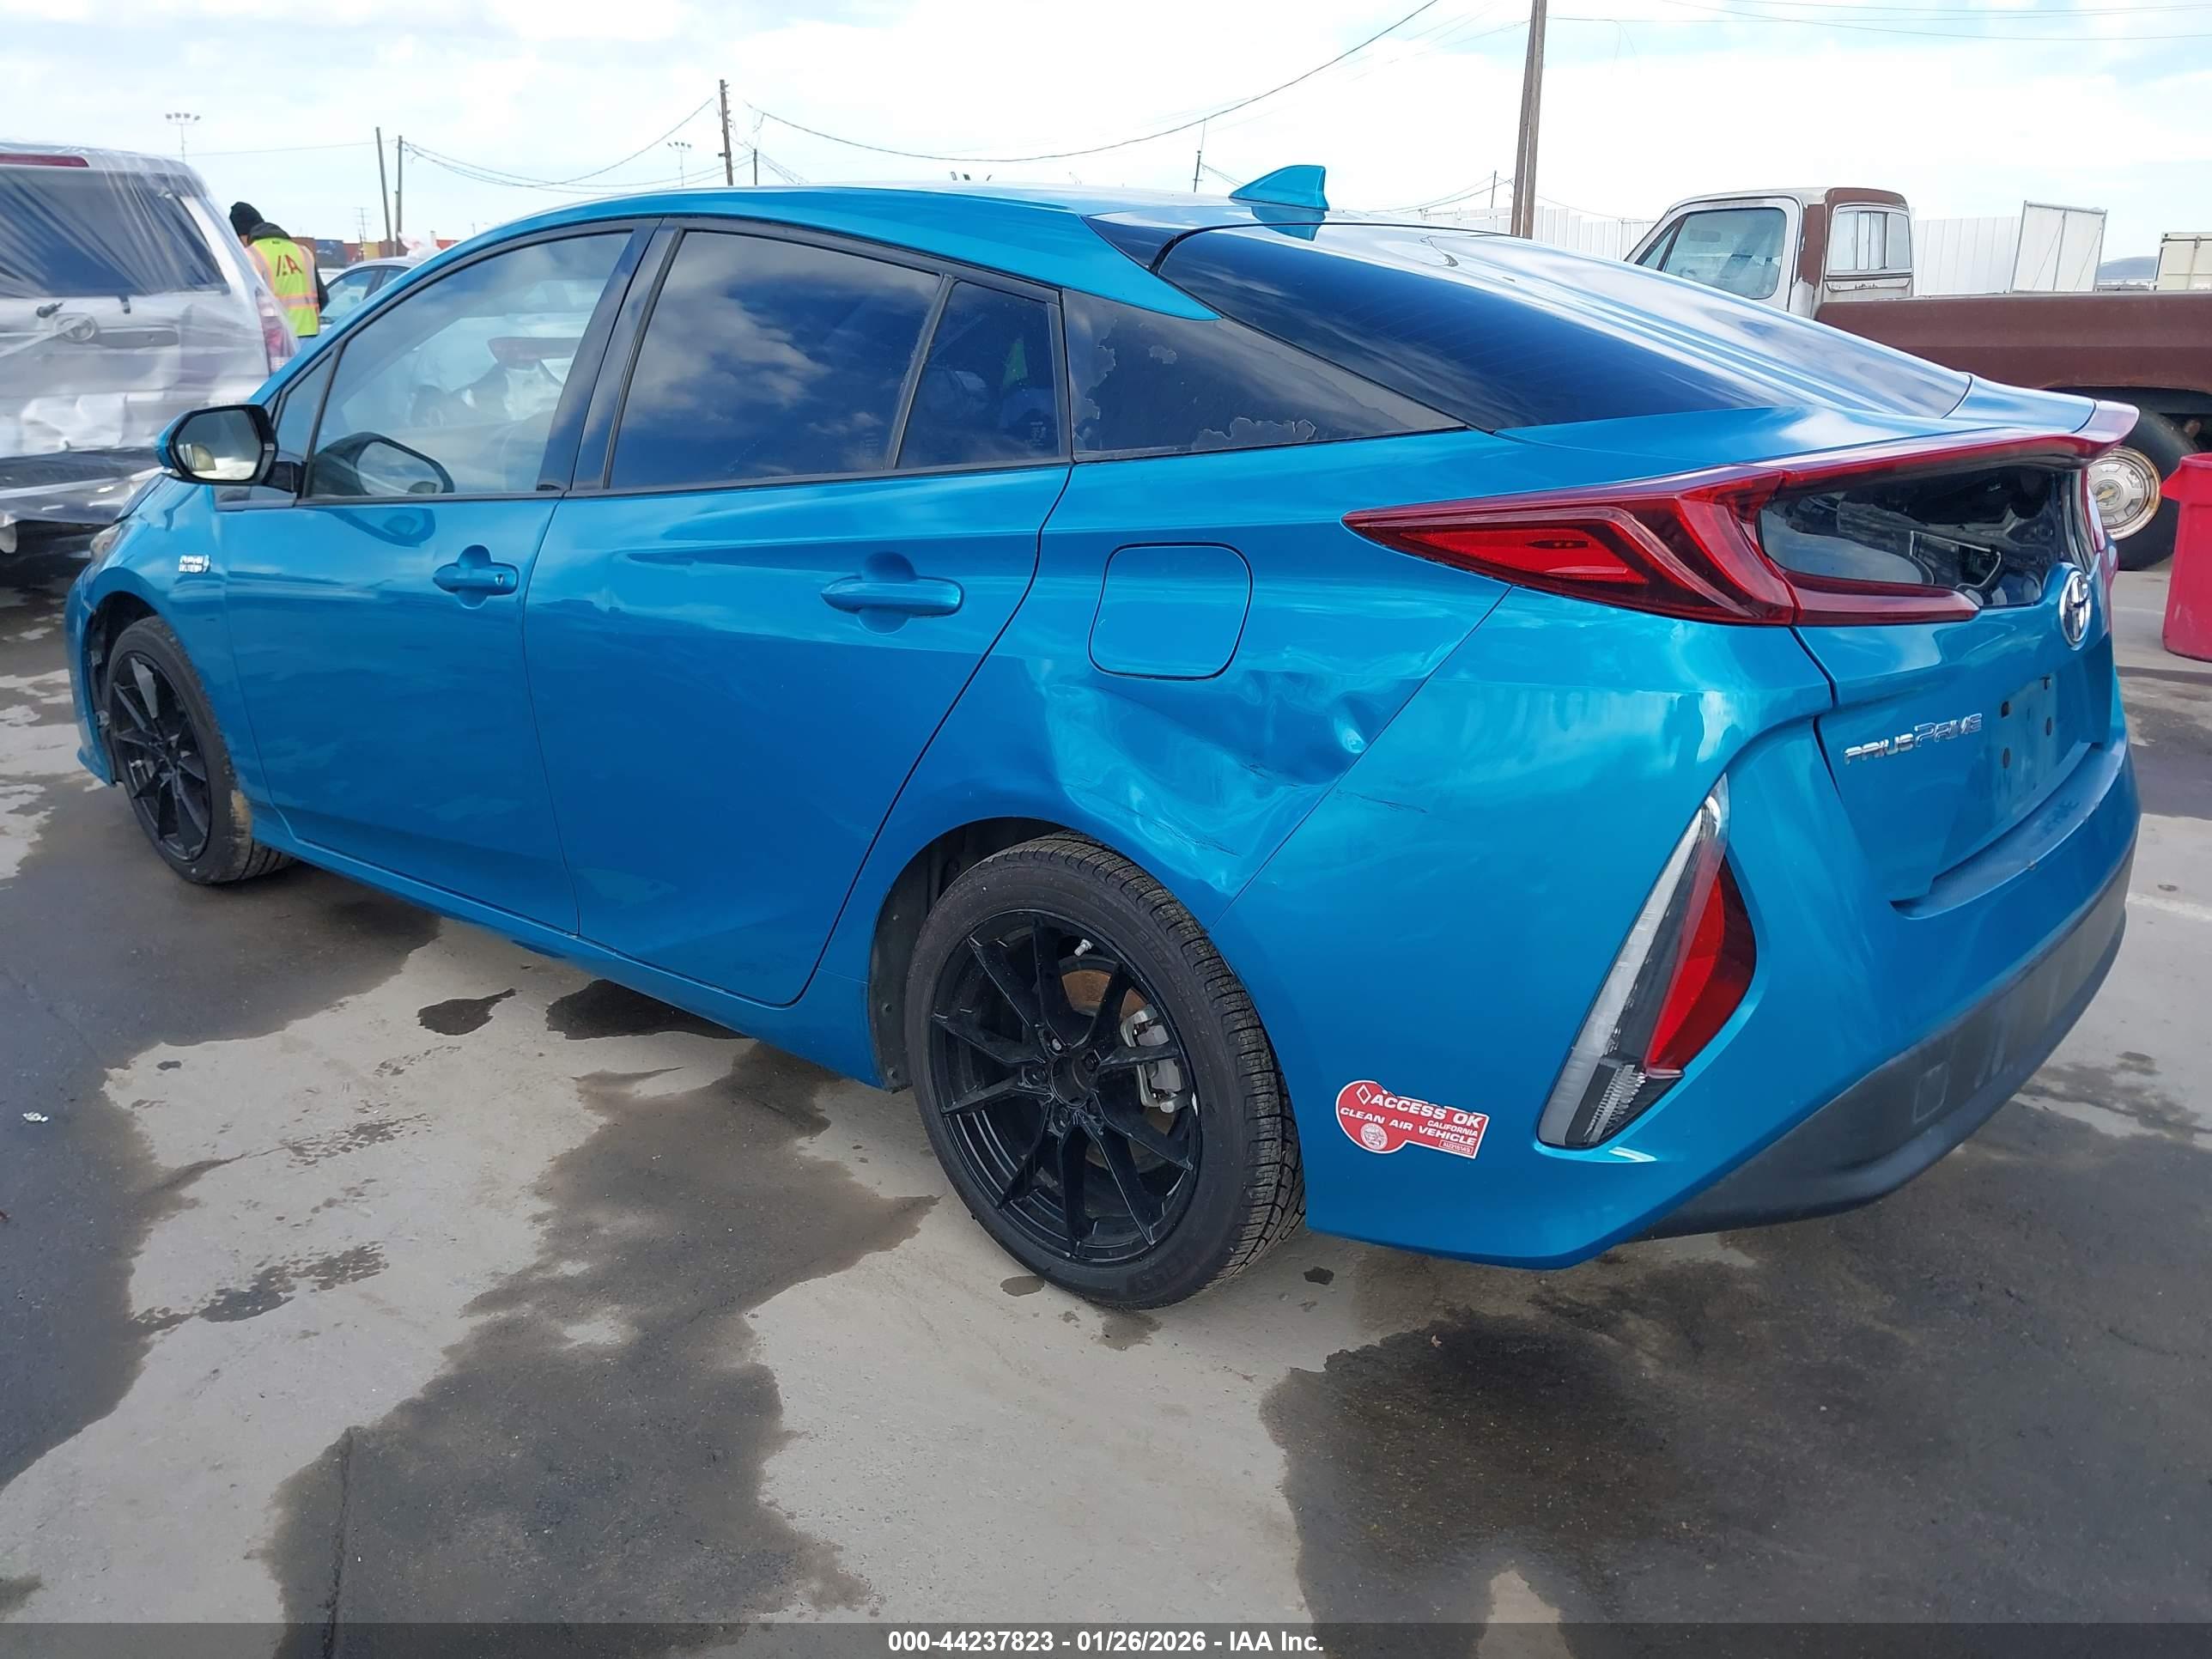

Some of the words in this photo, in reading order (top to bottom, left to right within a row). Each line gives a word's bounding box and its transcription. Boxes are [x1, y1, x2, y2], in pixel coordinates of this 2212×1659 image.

[1340, 1107, 1385, 1124] CLEAN
[1389, 1119, 1413, 1131] AIR
[1418, 1126, 1478, 1146] VEHICLE
[1370, 1094, 1448, 1121] ACCESS
[1452, 1112, 1484, 1128] OK
[1427, 1120, 1479, 1137] CALIFORNIA
